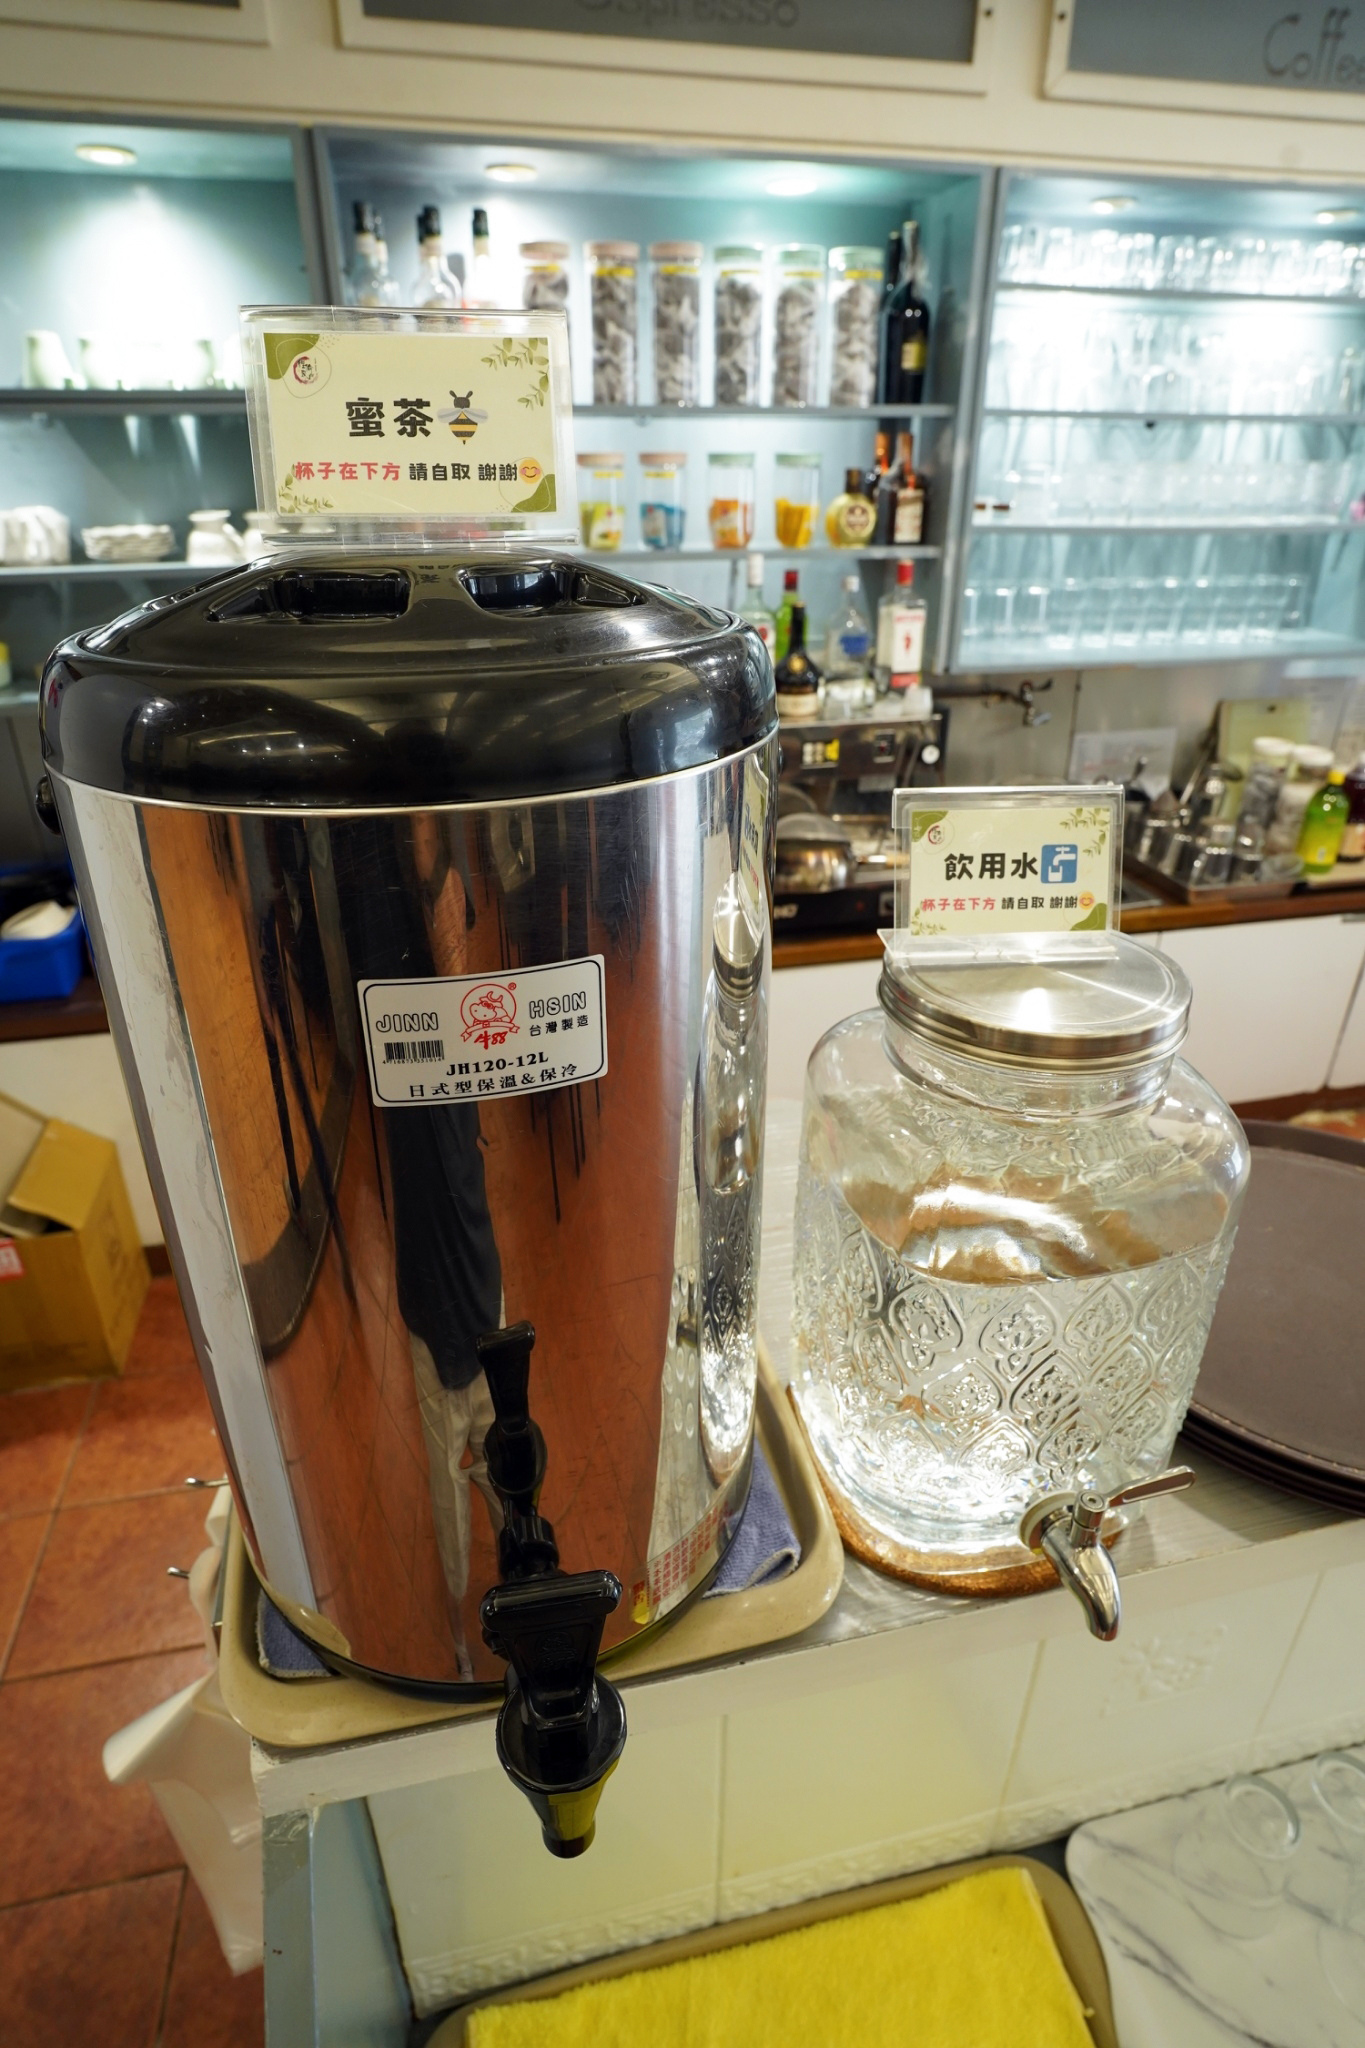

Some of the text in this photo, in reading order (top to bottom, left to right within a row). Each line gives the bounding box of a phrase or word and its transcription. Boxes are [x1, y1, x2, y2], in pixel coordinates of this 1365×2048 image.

[573, 0, 799, 27] spresso
[345, 397, 434, 438] 蜜茶
[295, 461, 518, 482] 杯子在下方 請自取 謝謝
[944, 852, 1039, 881] 飲用水
[921, 896, 1078, 911] 杯子在下方 請自取 謝謝
[375, 991, 587, 1033] JINN HSIN
[529, 1015, 589, 1036] 台灣製造
[446, 1051, 549, 1077] JH120-12L
[409, 1063, 578, 1098] 日式型保溫&保冷
